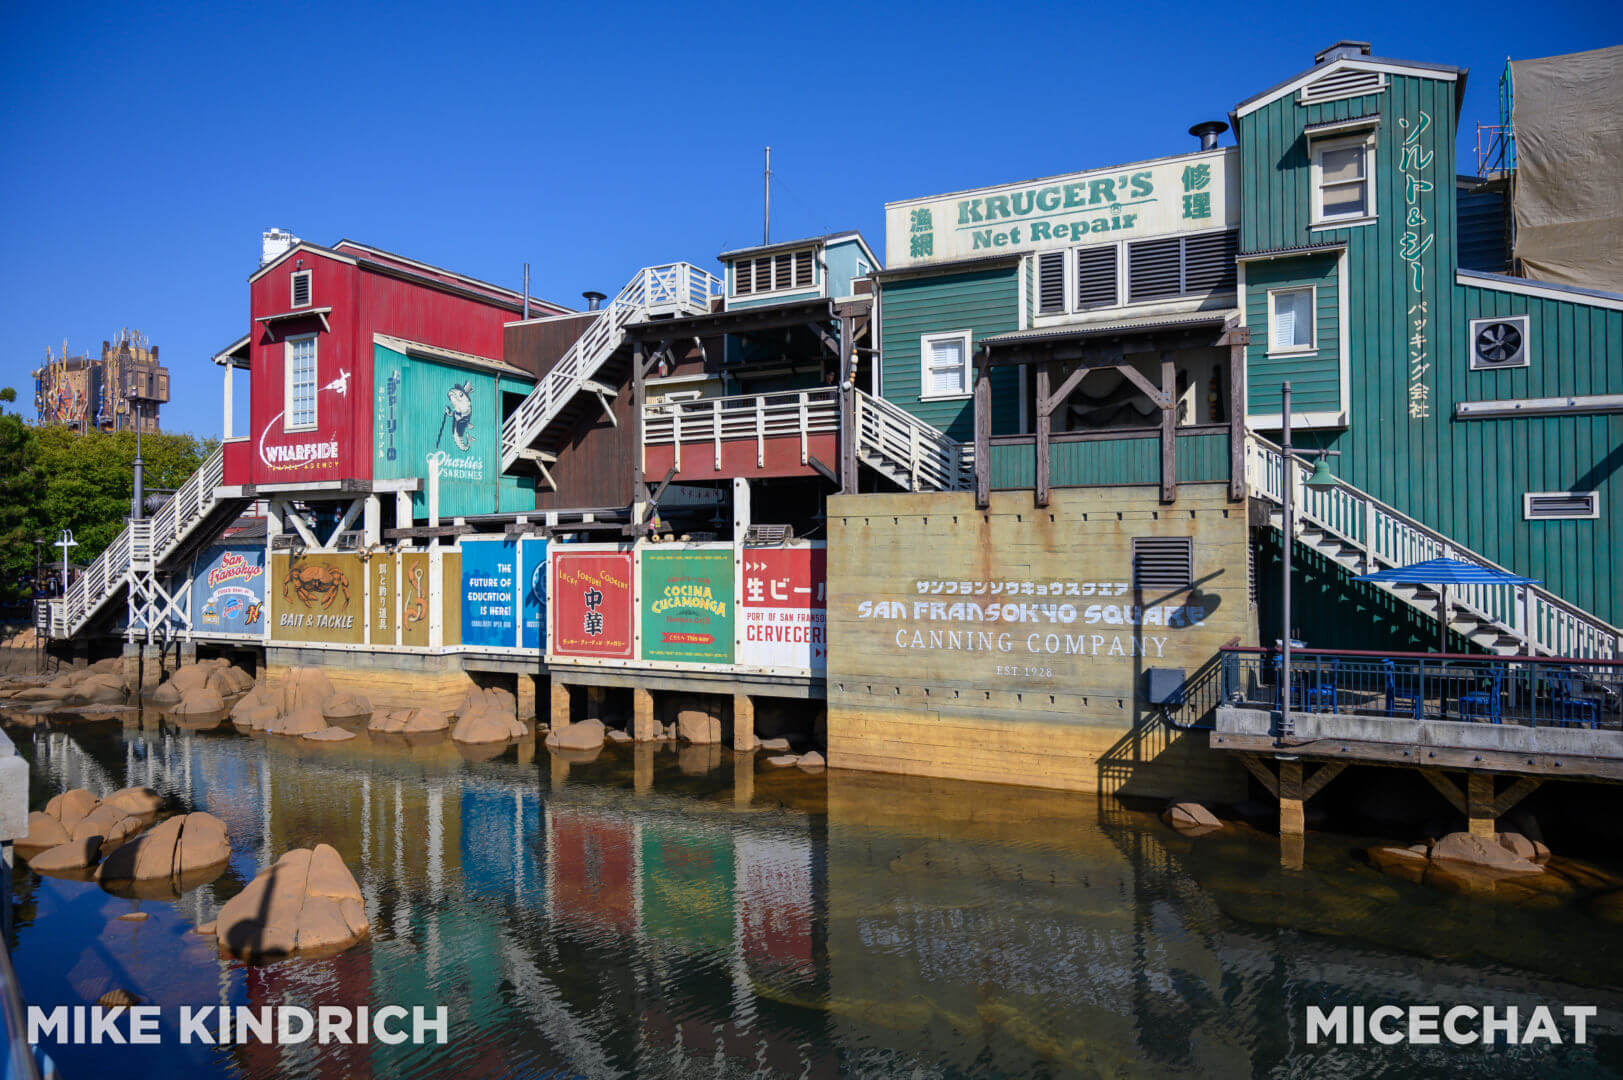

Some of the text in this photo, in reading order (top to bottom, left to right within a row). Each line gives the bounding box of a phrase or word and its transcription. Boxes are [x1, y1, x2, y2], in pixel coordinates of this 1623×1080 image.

[957, 171, 1154, 224] KRUGER'S
[1182, 164, 1211, 219] 修理
[972, 208, 1137, 249] Net Repair
[1408, 301, 1430, 419] パッキング会社
[265, 442, 338, 462] WHARFSIDE
[304, 461, 339, 470] AGENCY
[443, 469, 482, 480] SARDINES
[220, 552, 244, 570] San
[497, 563, 512, 573] THE
[469, 578, 512, 588] FUTURE OF
[467, 592, 511, 601] EDUCATION
[664, 585, 712, 600] COCINA
[480, 606, 512, 616] IS HERE!
[584, 587, 603, 636] 中華
[651, 597, 726, 618] CUCAMONGA
[857, 601, 1206, 627] SAN FRANSOKYO SQUARE
[280, 613, 354, 629] BAIT & TACKLE
[747, 613, 827, 623] PORT OF SAN FRANSO
[895, 629, 1168, 658] CANNING COMPANY
[996, 665, 1053, 678] EST 1928
